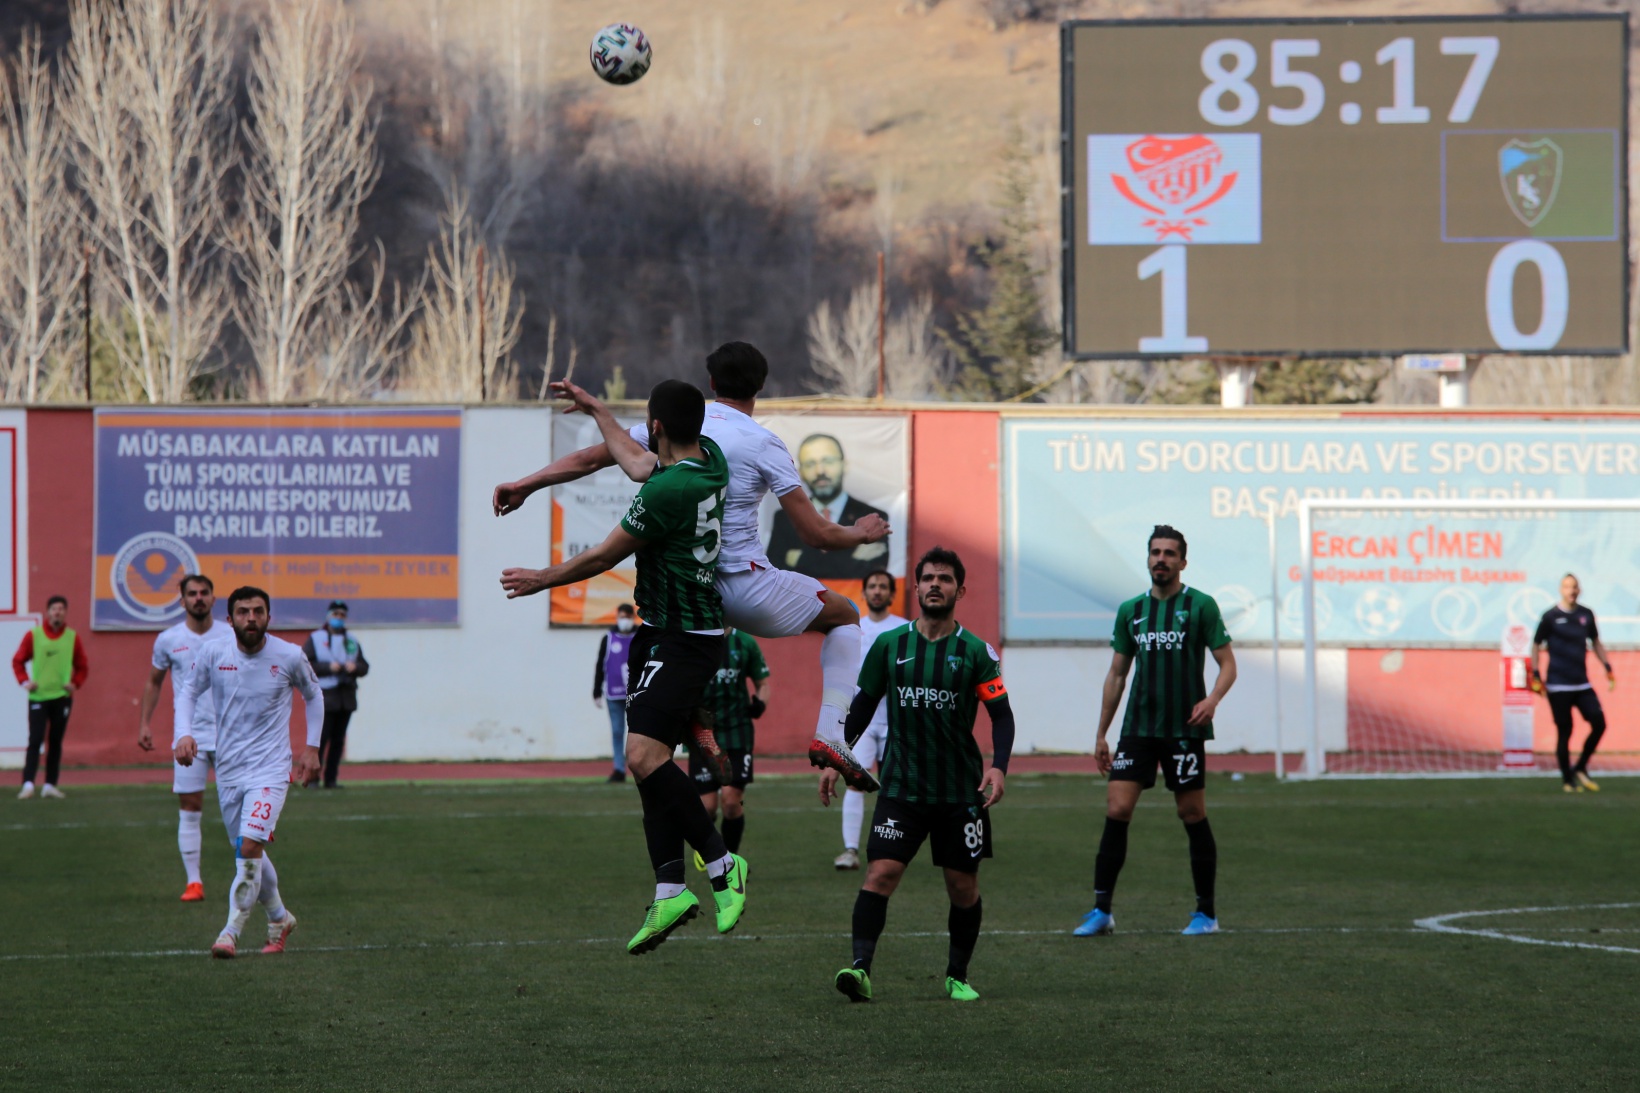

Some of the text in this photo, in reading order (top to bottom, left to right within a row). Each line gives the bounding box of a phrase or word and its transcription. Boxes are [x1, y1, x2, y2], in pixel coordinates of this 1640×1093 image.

[1198, 36, 1499, 126] 85:17
[1137, 244, 1208, 353] 1
[1485, 239, 1569, 350] 0
[117, 429, 439, 457] MÜSABAKALARA KATILAN
[1047, 433, 1640, 475] TÜM SPORCULARA VE SPORSEVER
[144, 458, 411, 486] TÜM SPORCULARIMIZA VE
[144, 484, 412, 516] GÜMÜŞHANESPOR'UMUZA
[174, 511, 383, 543] BAŞARILAR DİLERİZ.
[1407, 524, 1503, 565] ÇİMEN
[223, 561, 257, 575] Prof.
[384, 562, 450, 575] ZEYBEK
[1288, 565, 1385, 585] GMÜŞHANE
[1134, 632, 1186, 645] YAPISOY
[897, 686, 960, 704] YAPISOY
[900, 699, 956, 710] BETON
[1173, 753, 1198, 776] 72
[251, 801, 272, 820] 23
[874, 825, 904, 839] YELKENT
[880, 832, 896, 841] YAPI
[964, 819, 984, 849] 89
